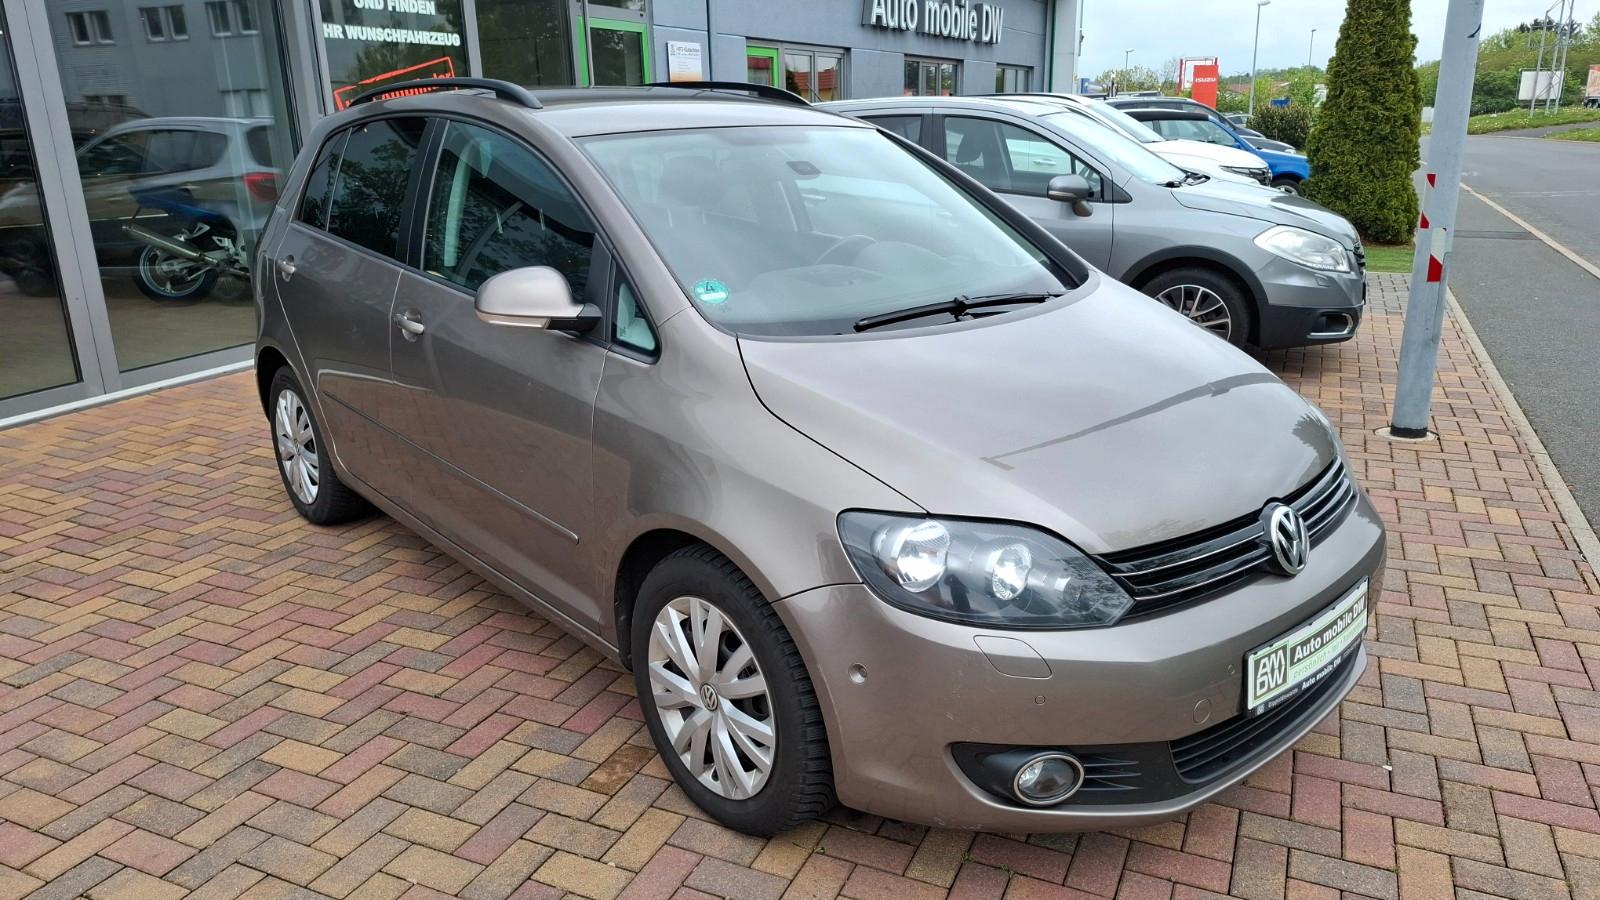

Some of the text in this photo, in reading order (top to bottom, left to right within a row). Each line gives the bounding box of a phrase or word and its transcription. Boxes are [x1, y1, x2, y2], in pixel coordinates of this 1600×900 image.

[354, 0, 436, 15] UND FINDEN
[870, 0, 1004, 43] Auto mobile DW
[344, 25, 461, 46] WUNSCHFAHRZEUG
[1293, 637, 1322, 664] Auto
[1322, 611, 1354, 645] mobile
[1353, 595, 1366, 619] DW
[1301, 676, 1316, 691] Auto
